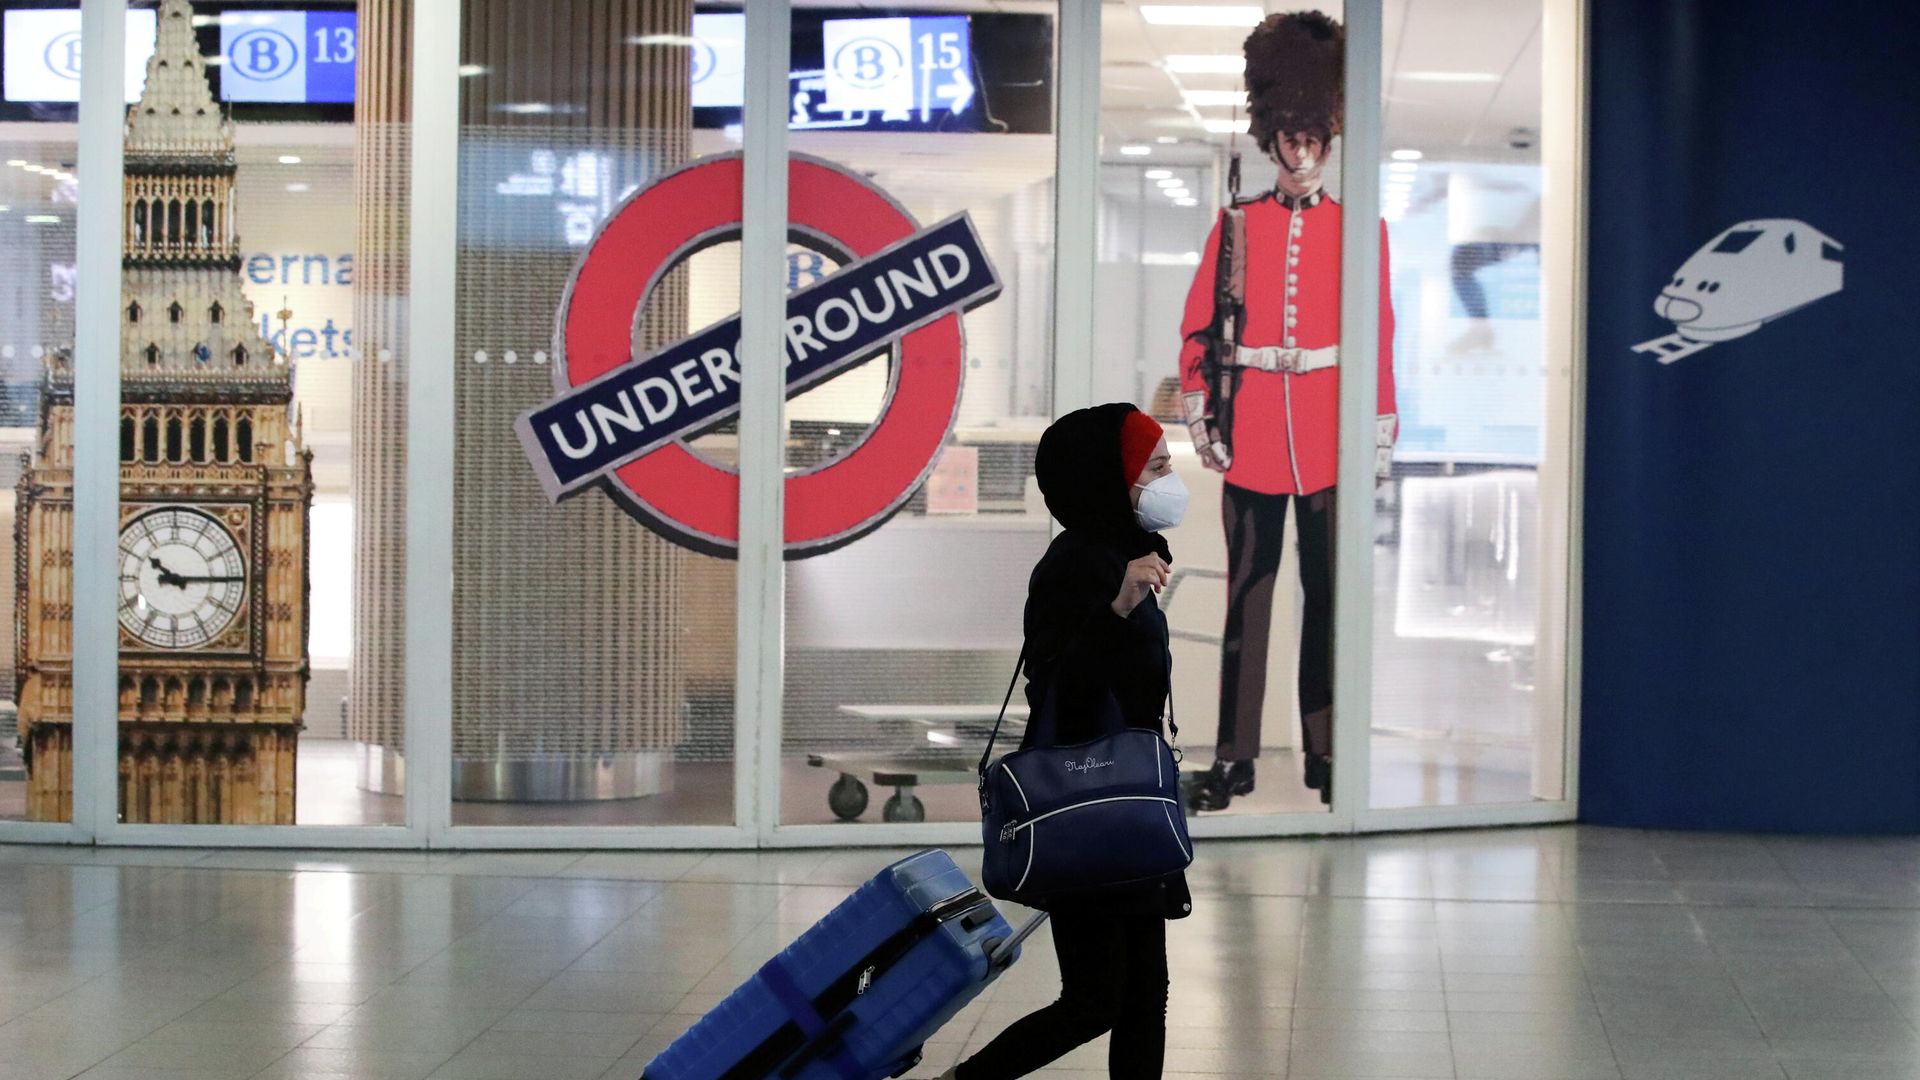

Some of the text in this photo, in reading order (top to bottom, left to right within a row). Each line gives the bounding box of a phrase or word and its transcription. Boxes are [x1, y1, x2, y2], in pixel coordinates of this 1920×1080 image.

[247, 27, 355, 73] B 13
[853, 32, 962, 81] B 15
[549, 243, 971, 459] UNDERROUND
